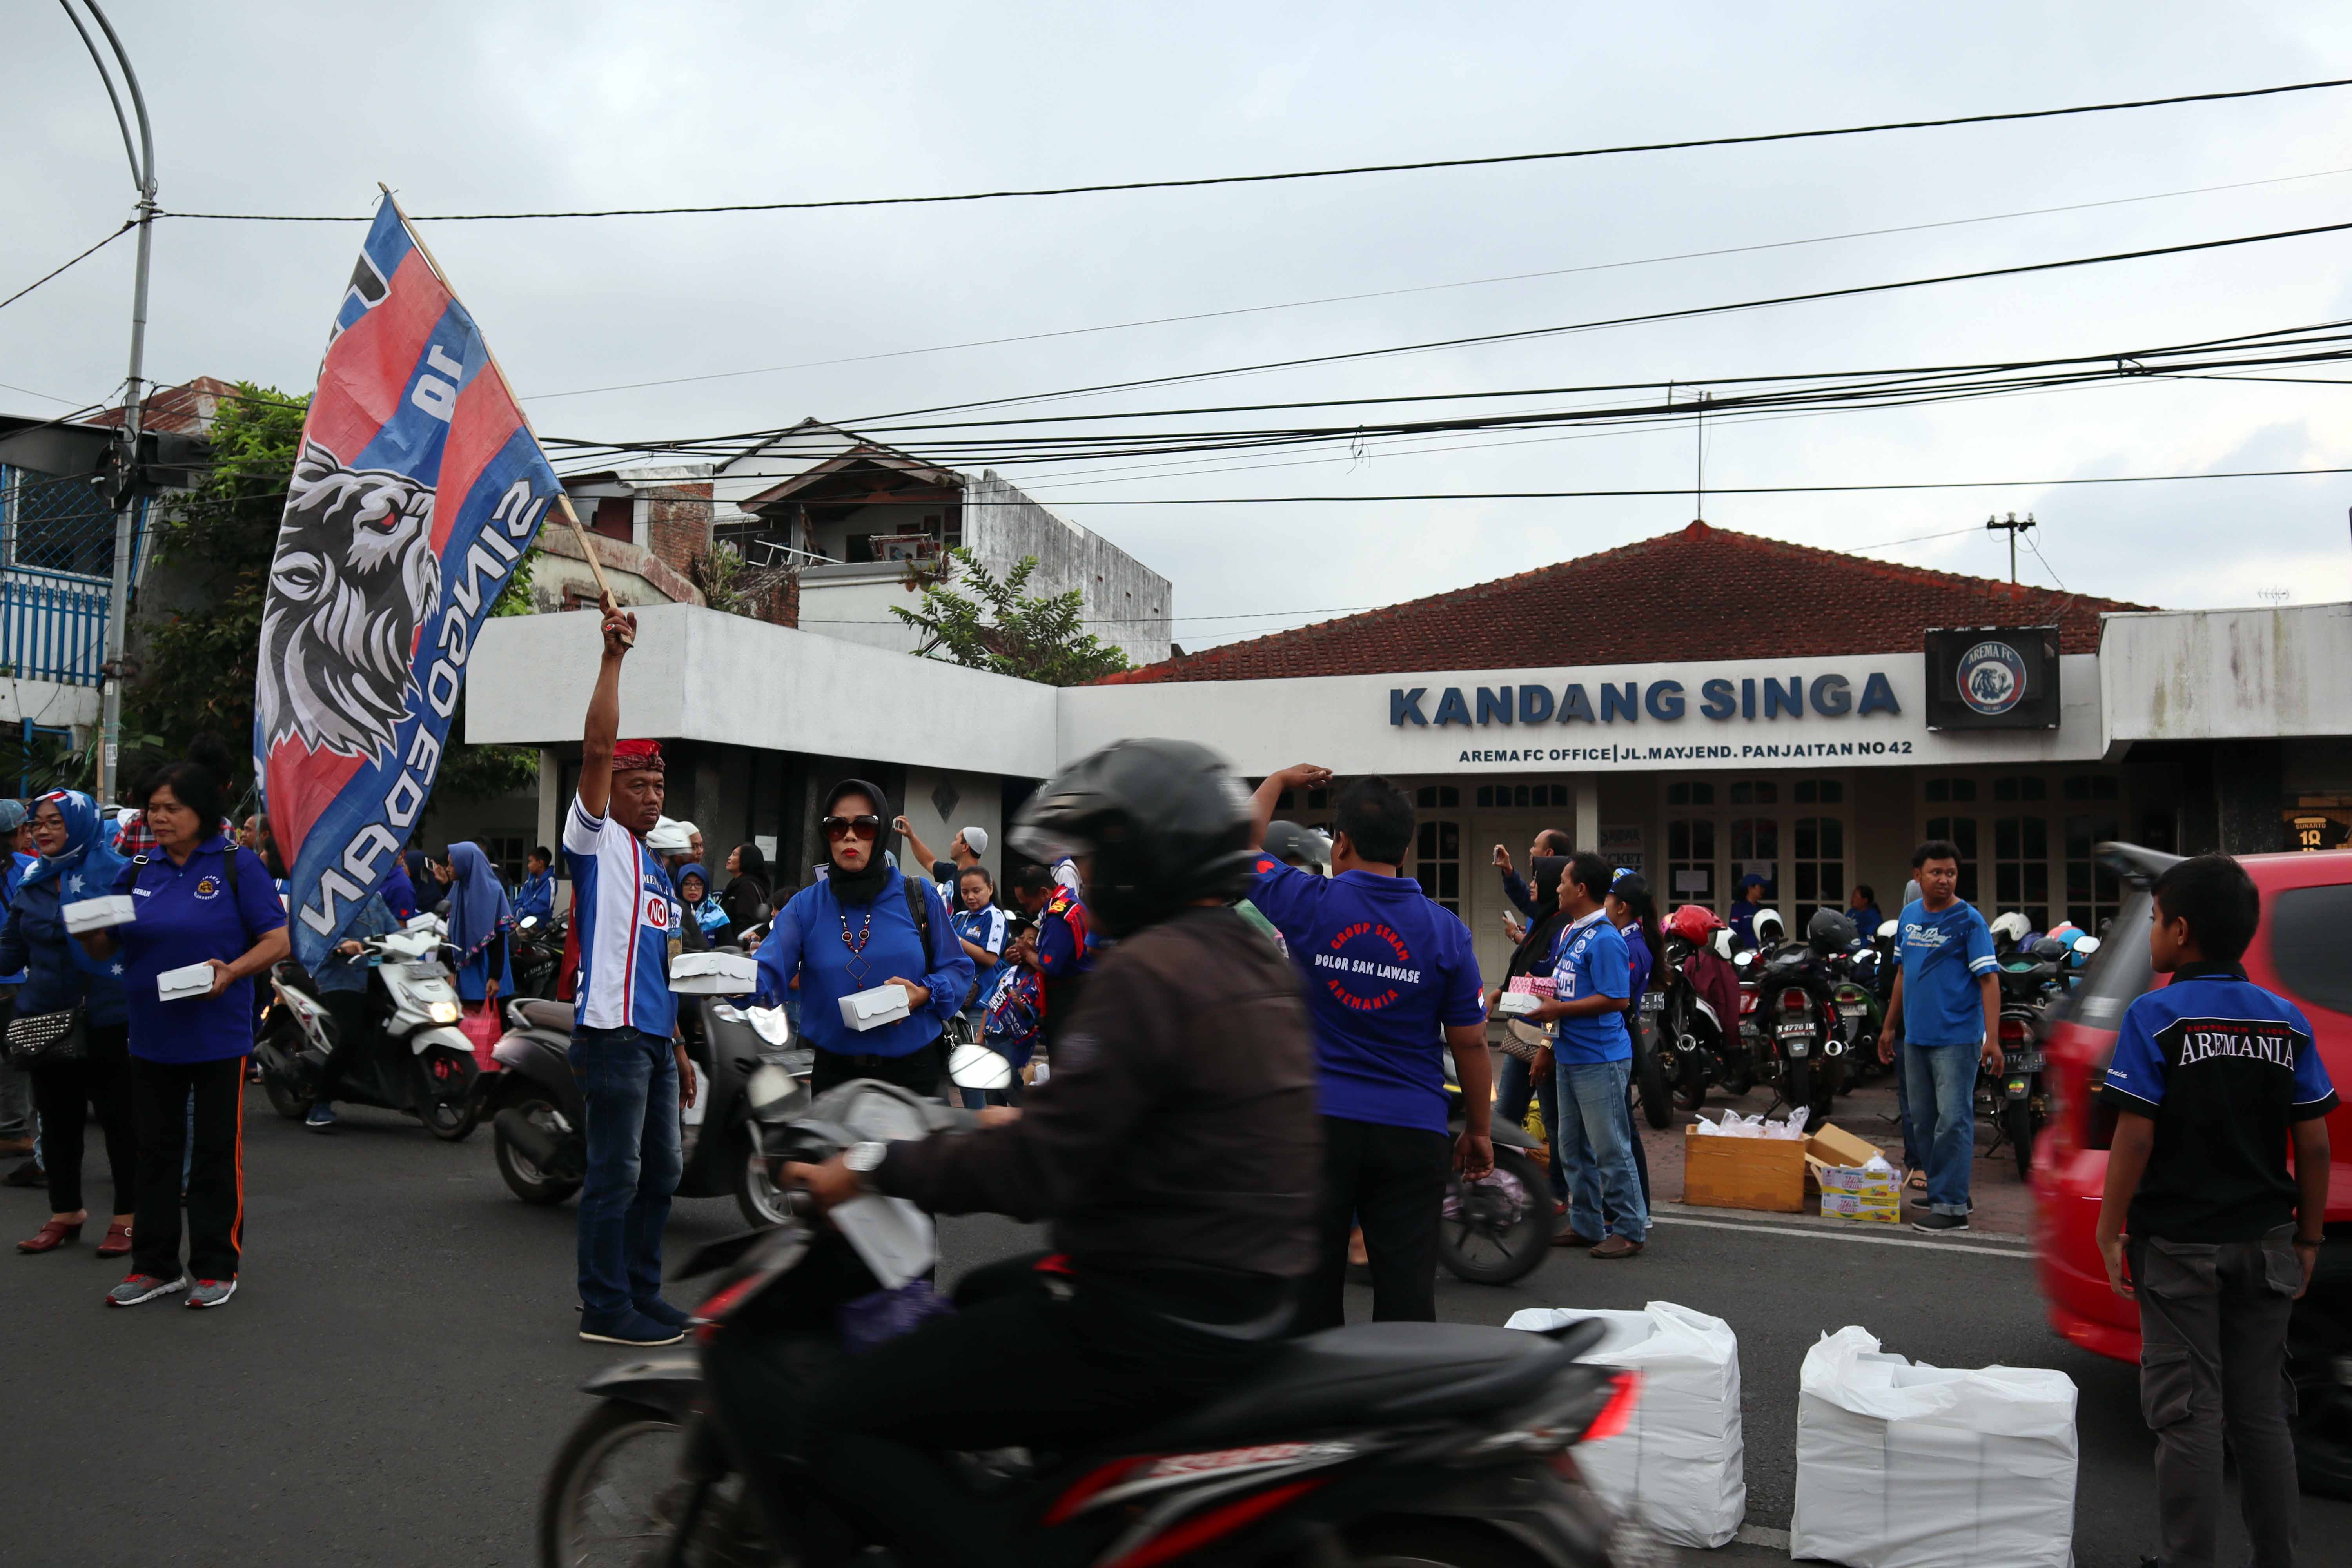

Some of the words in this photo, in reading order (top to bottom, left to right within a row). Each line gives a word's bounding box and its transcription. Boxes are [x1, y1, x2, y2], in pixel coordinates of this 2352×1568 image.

[1969, 644, 1999, 665] AREMA
[2002, 646, 2013, 662] FC
[1390, 680, 1686, 726] KANDANG
[1700, 672, 1902, 720] SINGA
[1459, 750, 1521, 762] AREMA
[1524, 749, 1544, 761] FC
[1742, 743, 1853, 757] PANJAITAN
[1859, 742, 1885, 755] NO
[1889, 741, 1913, 754] 42
[650, 900, 664, 924] NO
[1330, 922, 1371, 950] GROUP
[1375, 924, 1410, 962] SENAM
[1315, 953, 1349, 971] DOLOR
[1351, 959, 1375, 975] SAK
[1376, 964, 1421, 984] LAWASE
[1327, 979, 1399, 1011] AREMANIA
[2178, 1033, 2294, 1071] AREMANIA
